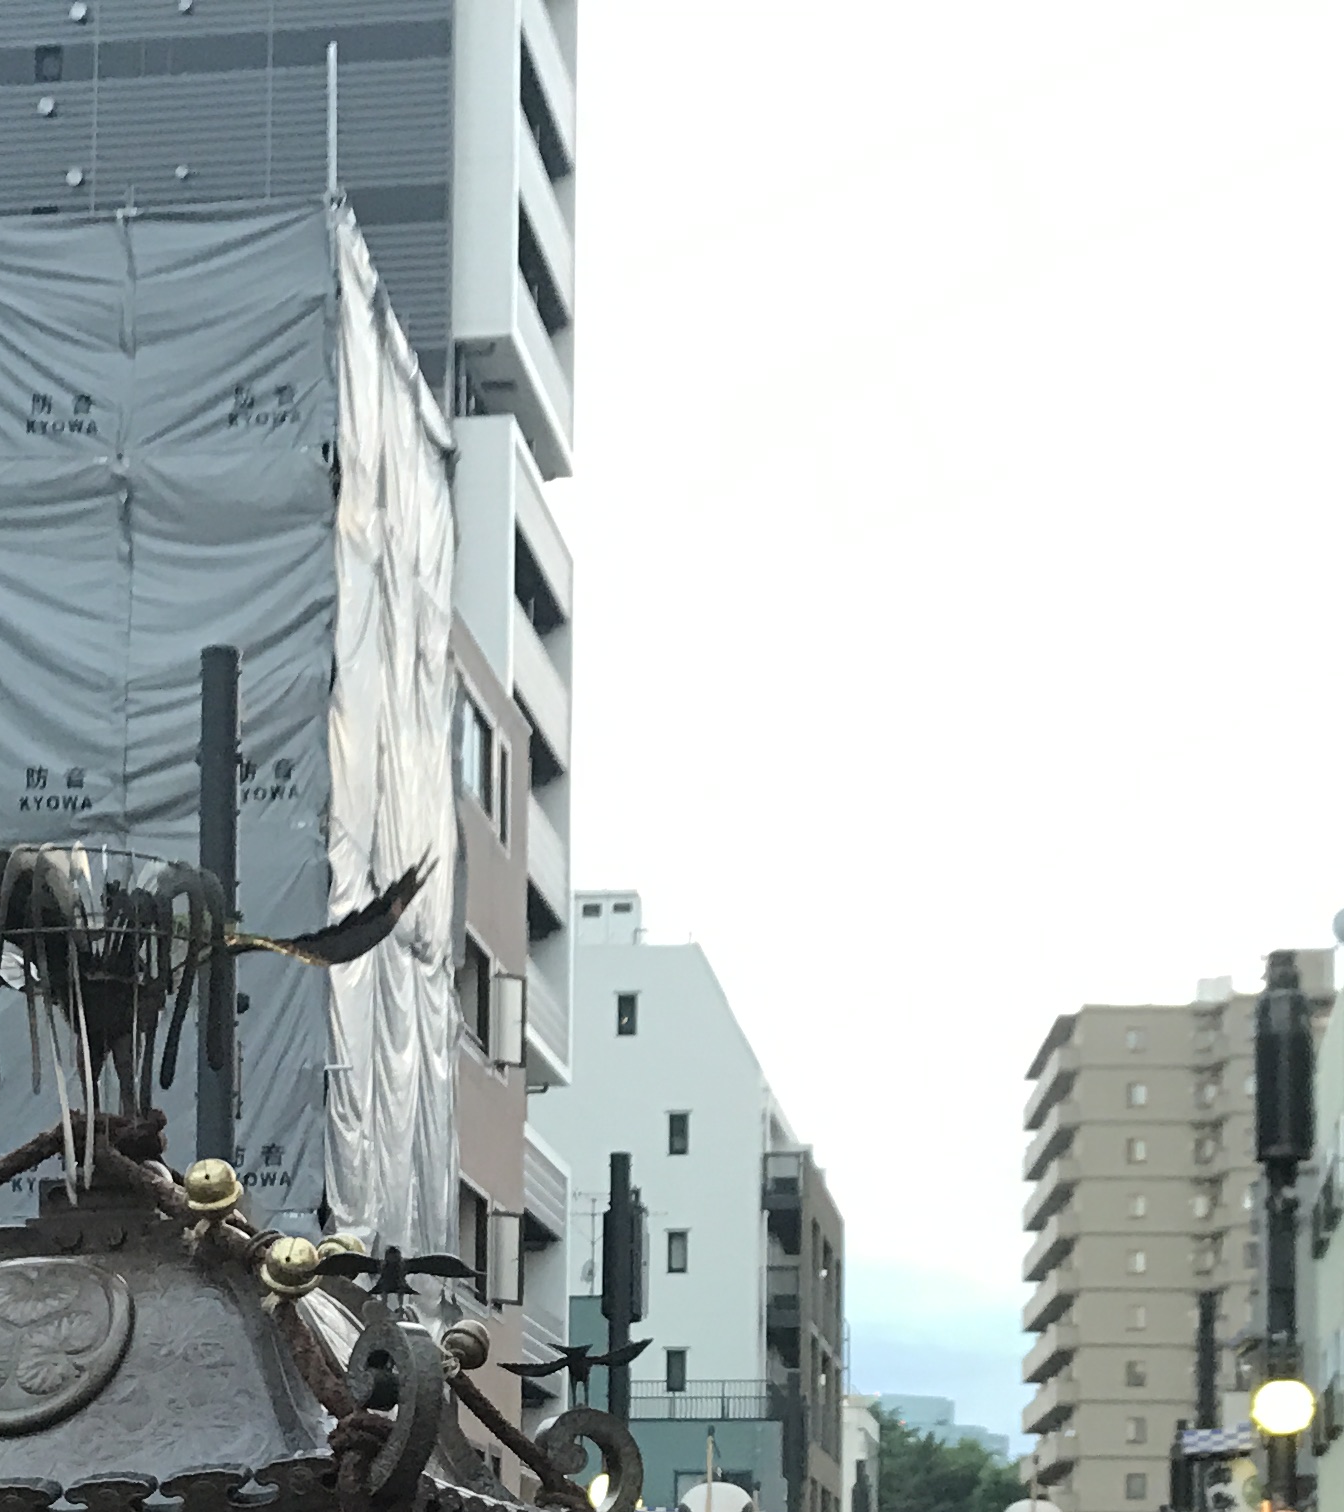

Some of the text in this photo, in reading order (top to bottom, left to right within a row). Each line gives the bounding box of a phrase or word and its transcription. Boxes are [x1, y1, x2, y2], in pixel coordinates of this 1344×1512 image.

[31, 393, 93, 416] 防音
[26, 418, 99, 436] KYOWA
[25, 767, 86, 790] 防音
[241, 784, 297, 803] YOWA
[20, 794, 94, 812] KYOWA
[236, 1170, 292, 1187] OWA
